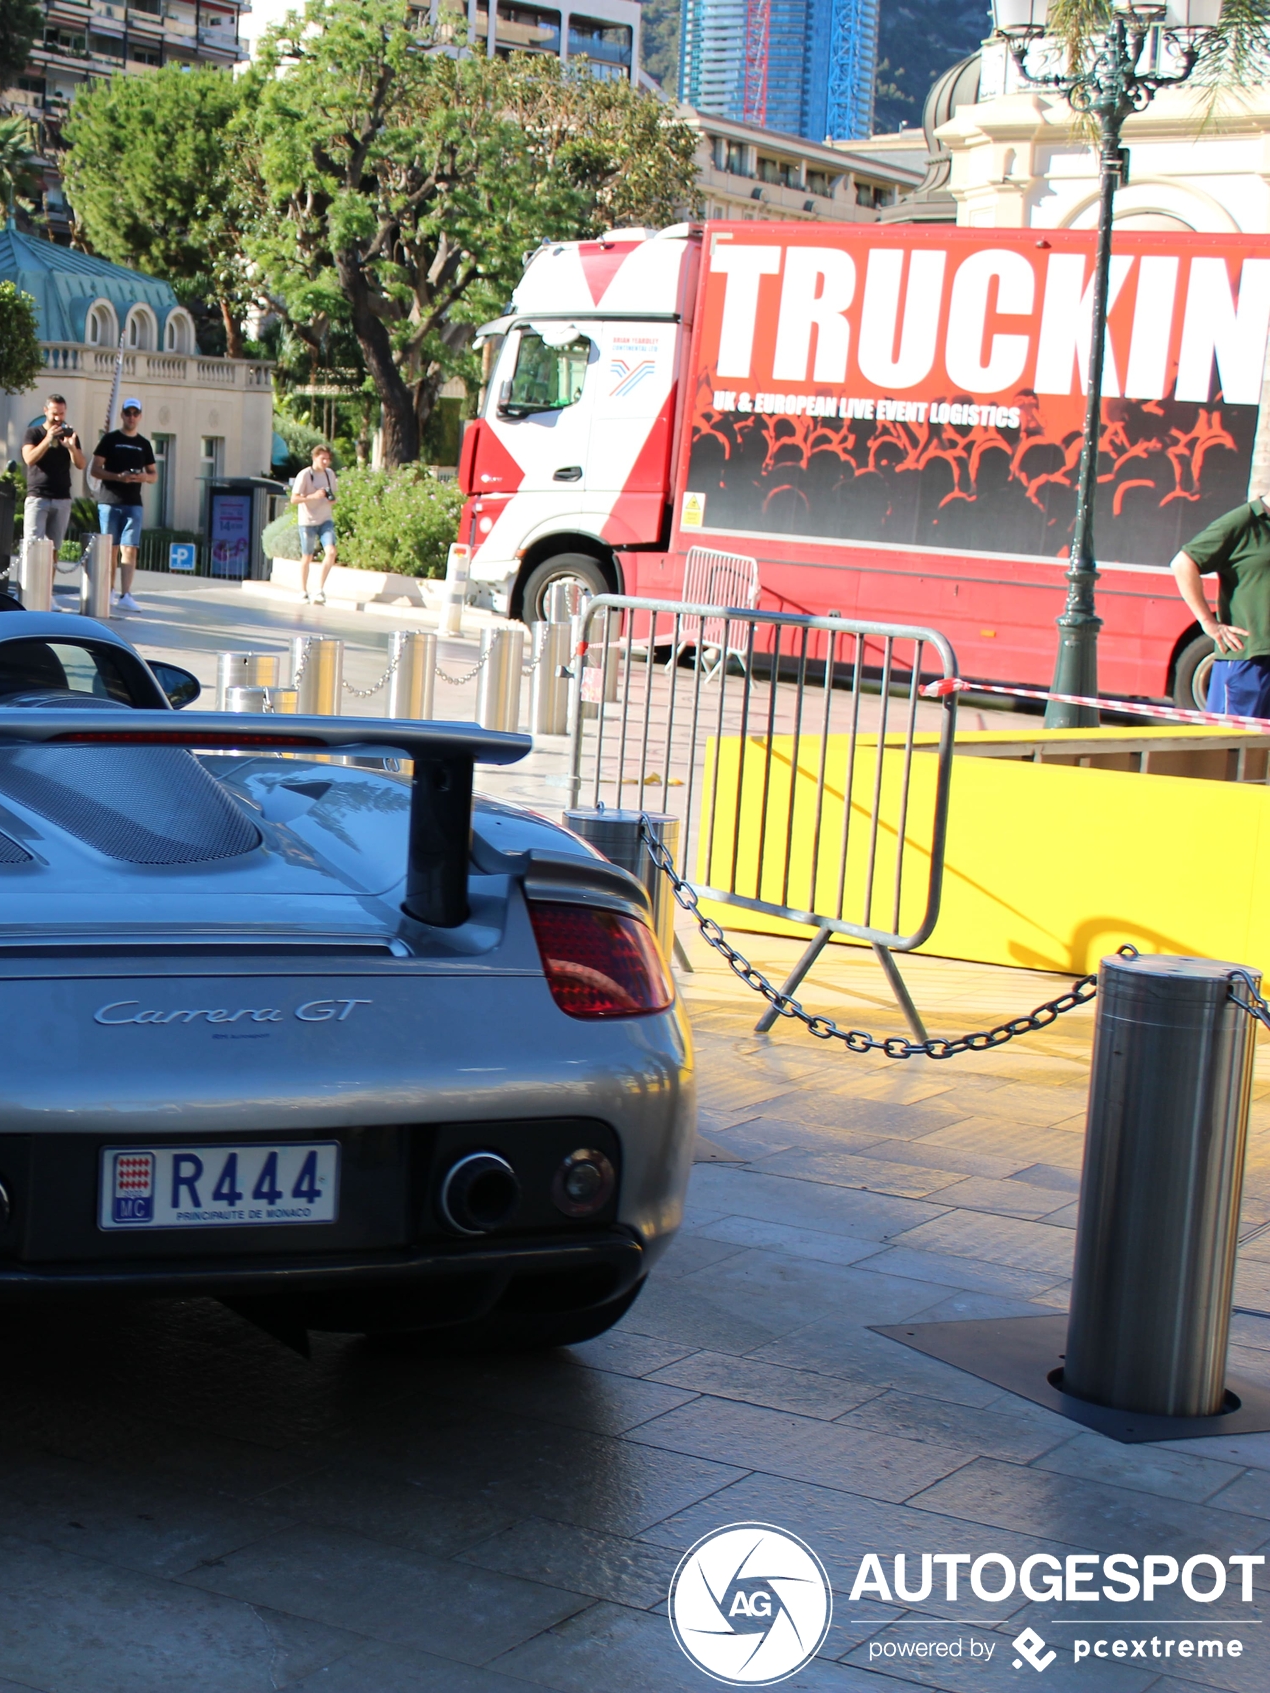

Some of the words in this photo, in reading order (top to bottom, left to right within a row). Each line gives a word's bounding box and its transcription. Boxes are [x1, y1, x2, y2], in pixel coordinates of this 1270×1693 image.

[709, 245, 1270, 405] TRUCKIN
[713, 390, 736, 411] UK
[738, 392, 752, 413] &
[754, 393, 838, 418] EUROPEAN
[839, 397, 875, 420] LIVE
[876, 398, 928, 423] EVENT
[929, 402, 1021, 429] LOGISTICS
[177, 548, 189, 564] P
[94, 1000, 283, 1025] Carrera
[295, 999, 373, 1021] GT
[171, 1150, 322, 1208] R444
[120, 1200, 145, 1217] MC
[176, 1210, 245, 1221] PRINCIPAUTE
[248, 1209, 262, 1218] DE
[266, 1208, 311, 1219] MONACO
